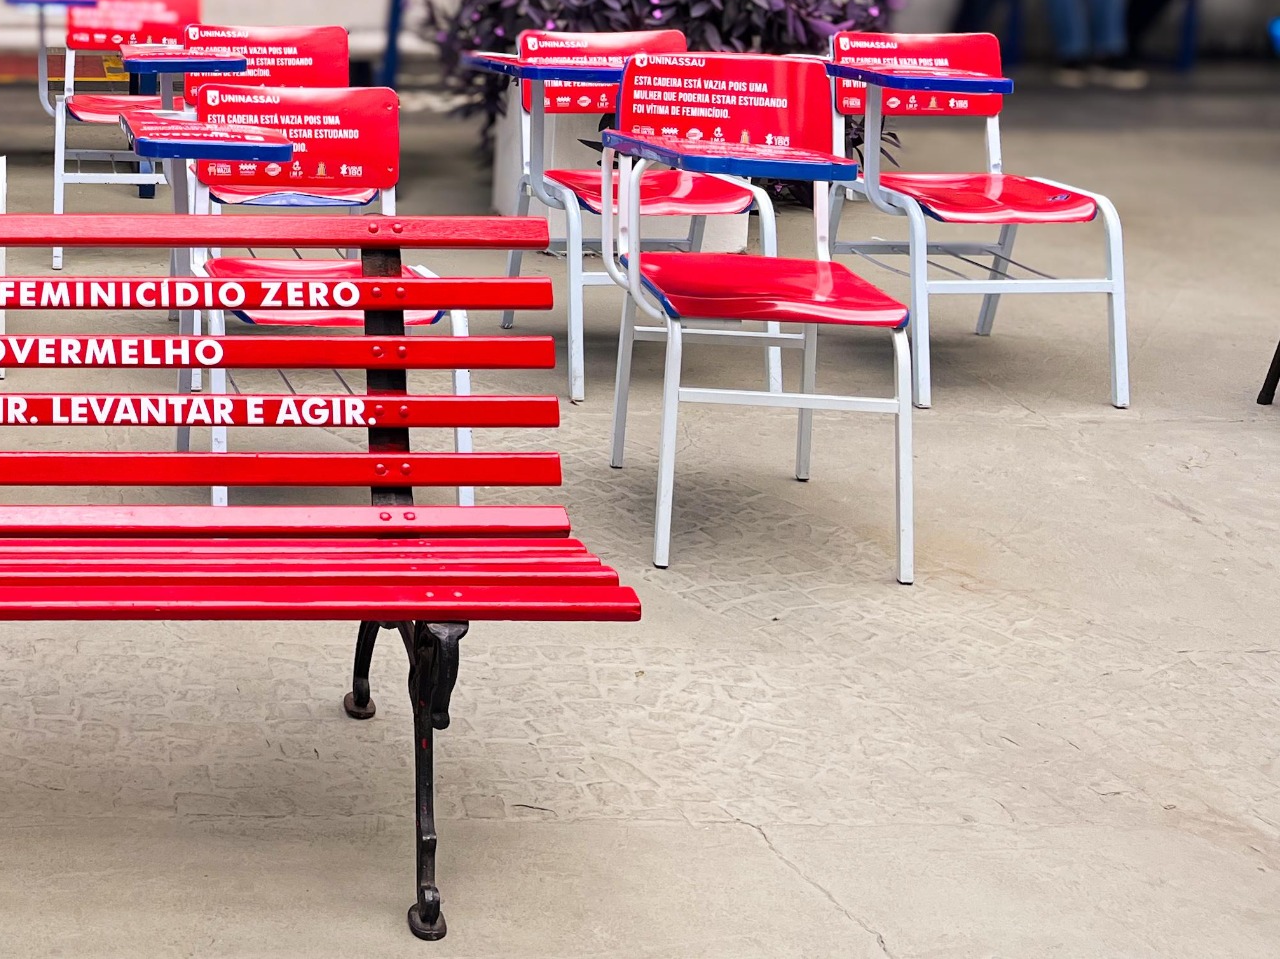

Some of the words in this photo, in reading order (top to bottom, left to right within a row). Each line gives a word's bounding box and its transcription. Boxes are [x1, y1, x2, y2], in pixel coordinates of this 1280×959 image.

[232, 46, 248, 54] ESTÁ
[850, 41, 897, 49] UNINASSAU
[650, 57, 705, 67] UNINASSAU
[883, 56, 898, 65] ESTÁ
[935, 58, 948, 66] UMA
[634, 76, 651, 86] ESTA
[653, 77, 681, 87] CADEIRA
[684, 77, 702, 89] ESTÁ
[704, 80, 726, 90] VAZIA
[729, 82, 747, 92] POIS
[749, 83, 768, 93] UMA
[221, 94, 280, 104] UNINASSAU
[634, 90, 661, 101] MULHER
[663, 92, 677, 102] QUE
[678, 93, 709, 103] PODERIA
[712, 95, 736, 105] ESTAR
[739, 96, 787, 108] ESTUDANDO
[633, 104, 644, 113] FOI
[646, 103, 669, 115] VÍTIMA
[671, 107, 680, 116] DE
[682, 107, 730, 119] FEMINICÍDIO.
[207, 115, 225, 124] ESTA
[227, 116, 259, 124] CADEIRA
[261, 114, 278, 124] ESTÁ
[280, 116, 302, 125] VAZIA
[304, 116, 321, 125] POIS
[323, 116, 340, 125] UMA
[289, 129, 312, 138] ESTAR
[314, 129, 358, 139] ESTUDANDO
[0, 280, 246, 307] FEMINICÍDIO
[260, 281, 361, 307] ZERO
[52, 397, 234, 425] LEVANTAR
[247, 397, 263, 425] E
[276, 397, 377, 426] AGIR.
